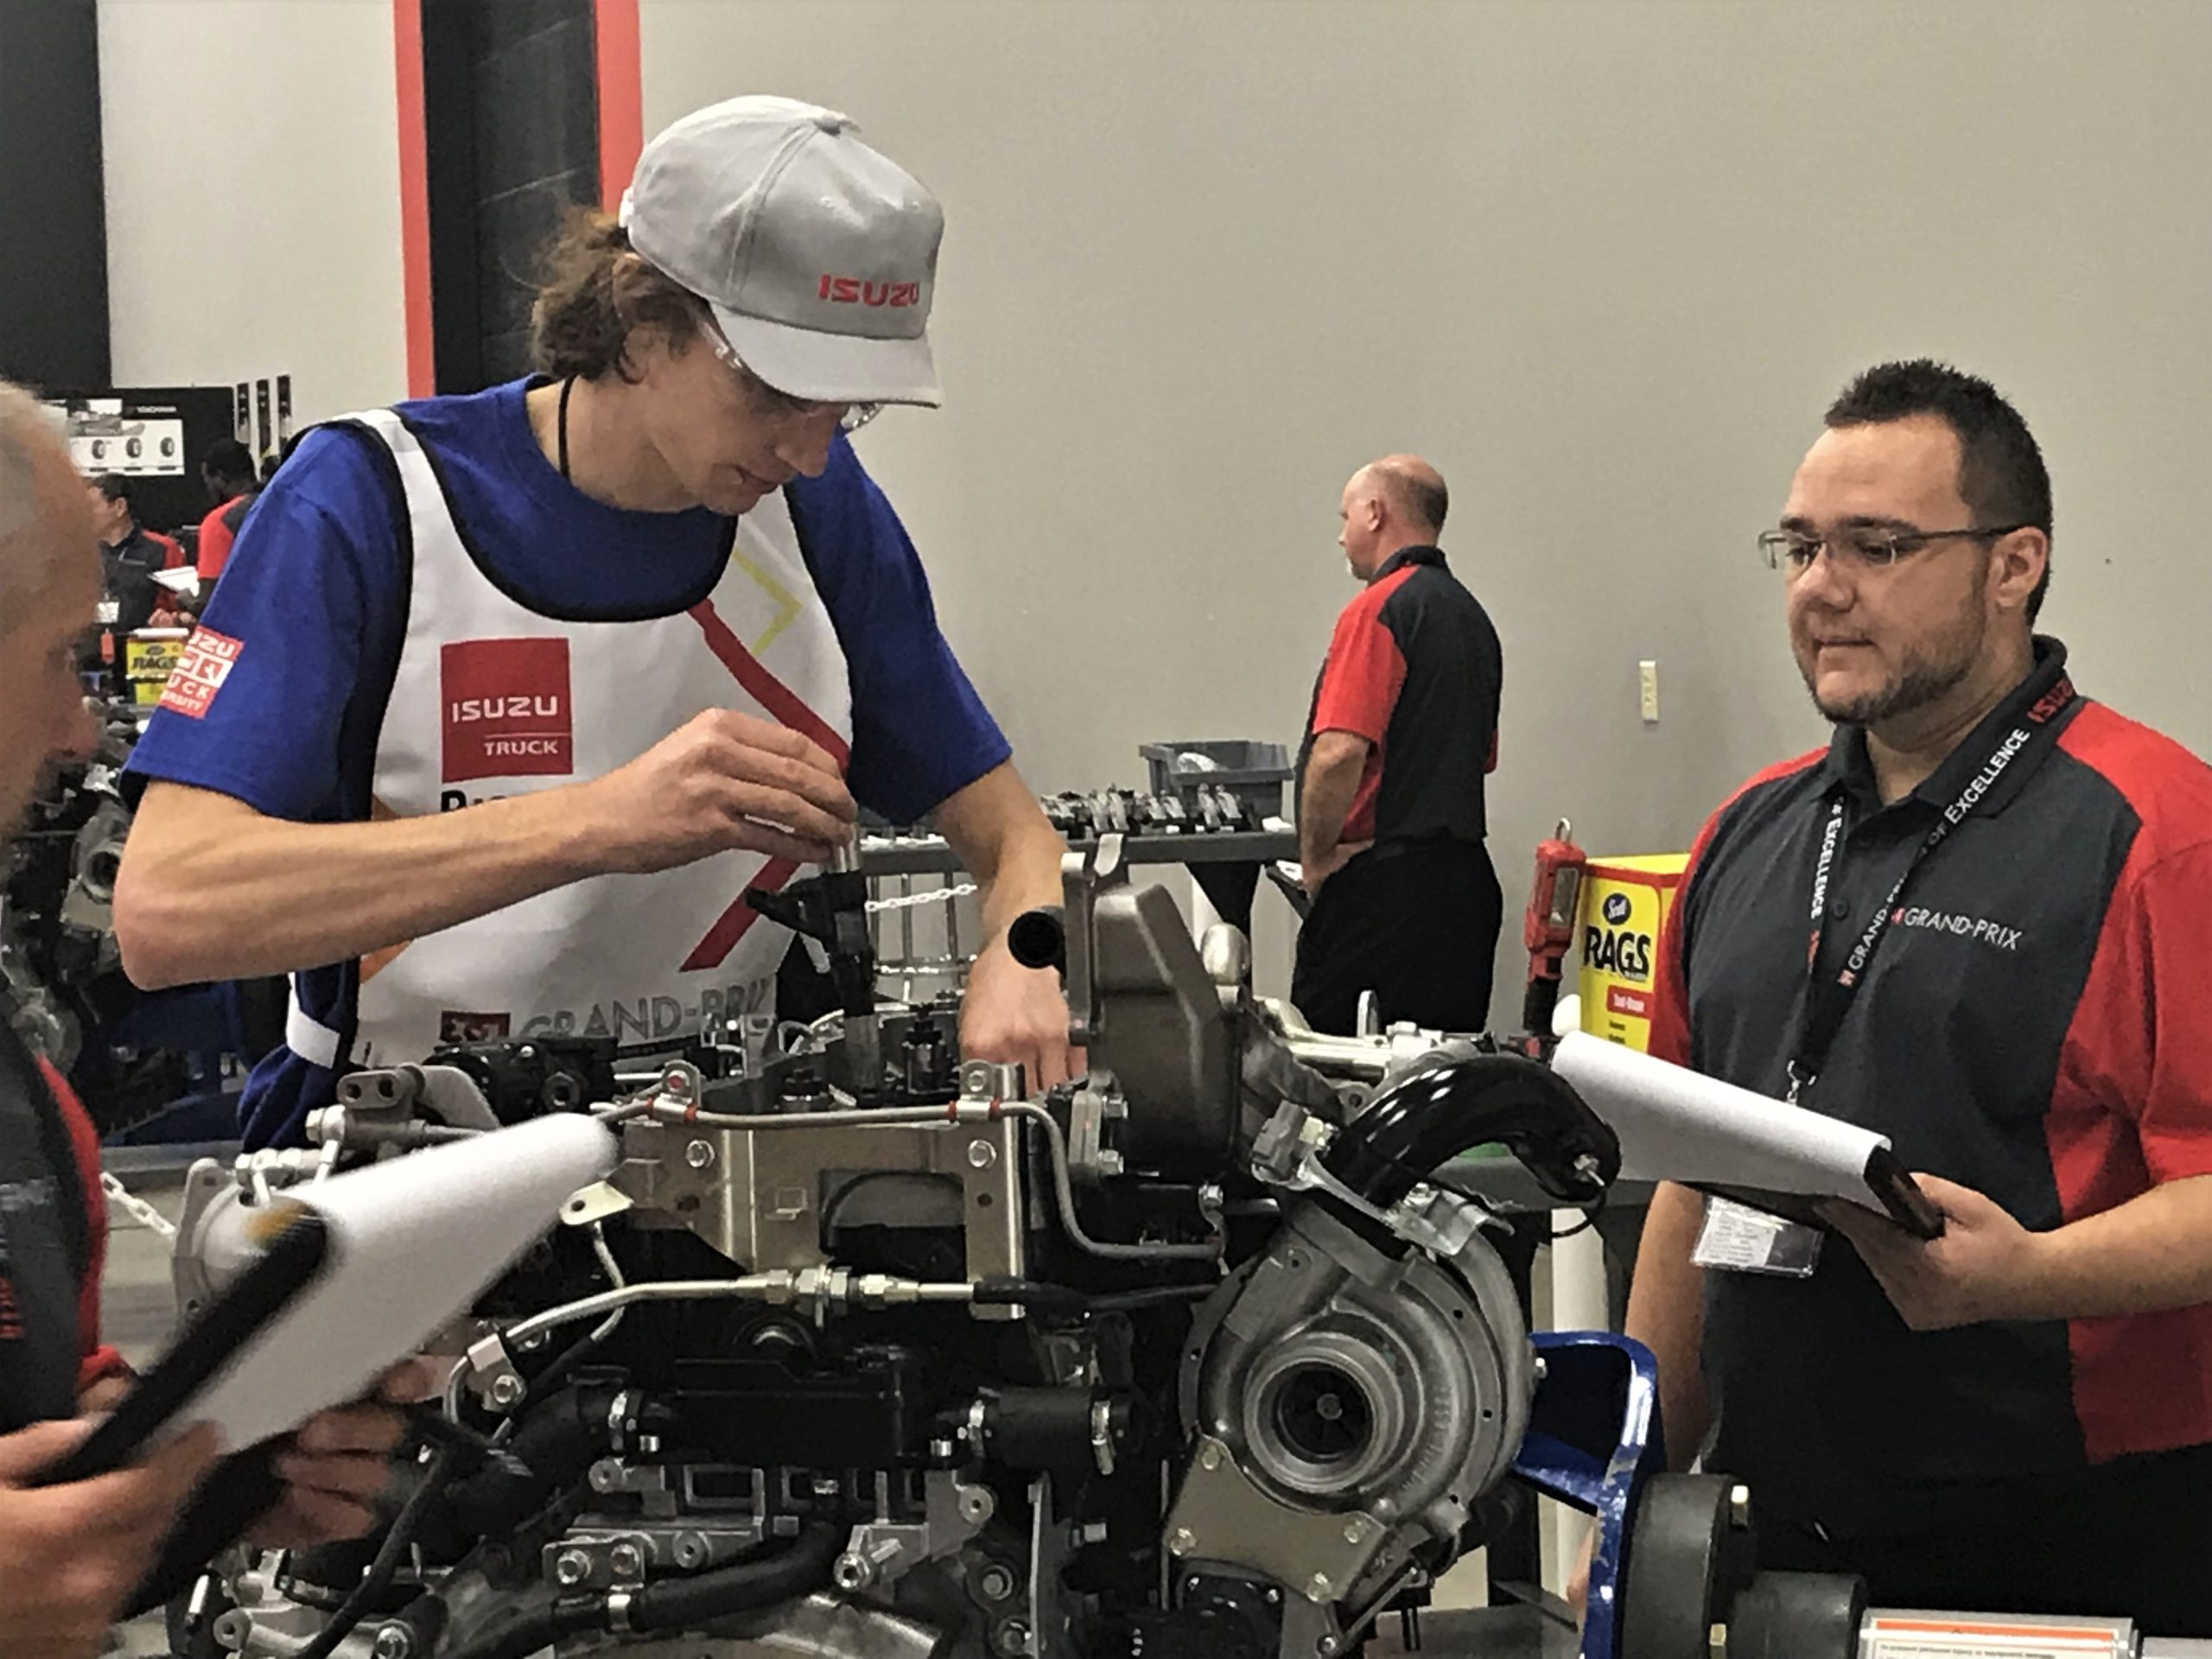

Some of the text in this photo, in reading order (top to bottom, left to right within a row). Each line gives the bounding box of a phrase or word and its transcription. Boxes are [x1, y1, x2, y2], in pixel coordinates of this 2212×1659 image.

[452, 696, 558, 723] ISUZU
[484, 741, 558, 756] TRUCK
[1944, 728, 2031, 824] EXCELLENCE
[1904, 907, 2023, 950] GRAND-PRIX
[1584, 925, 1651, 978] RAGS
